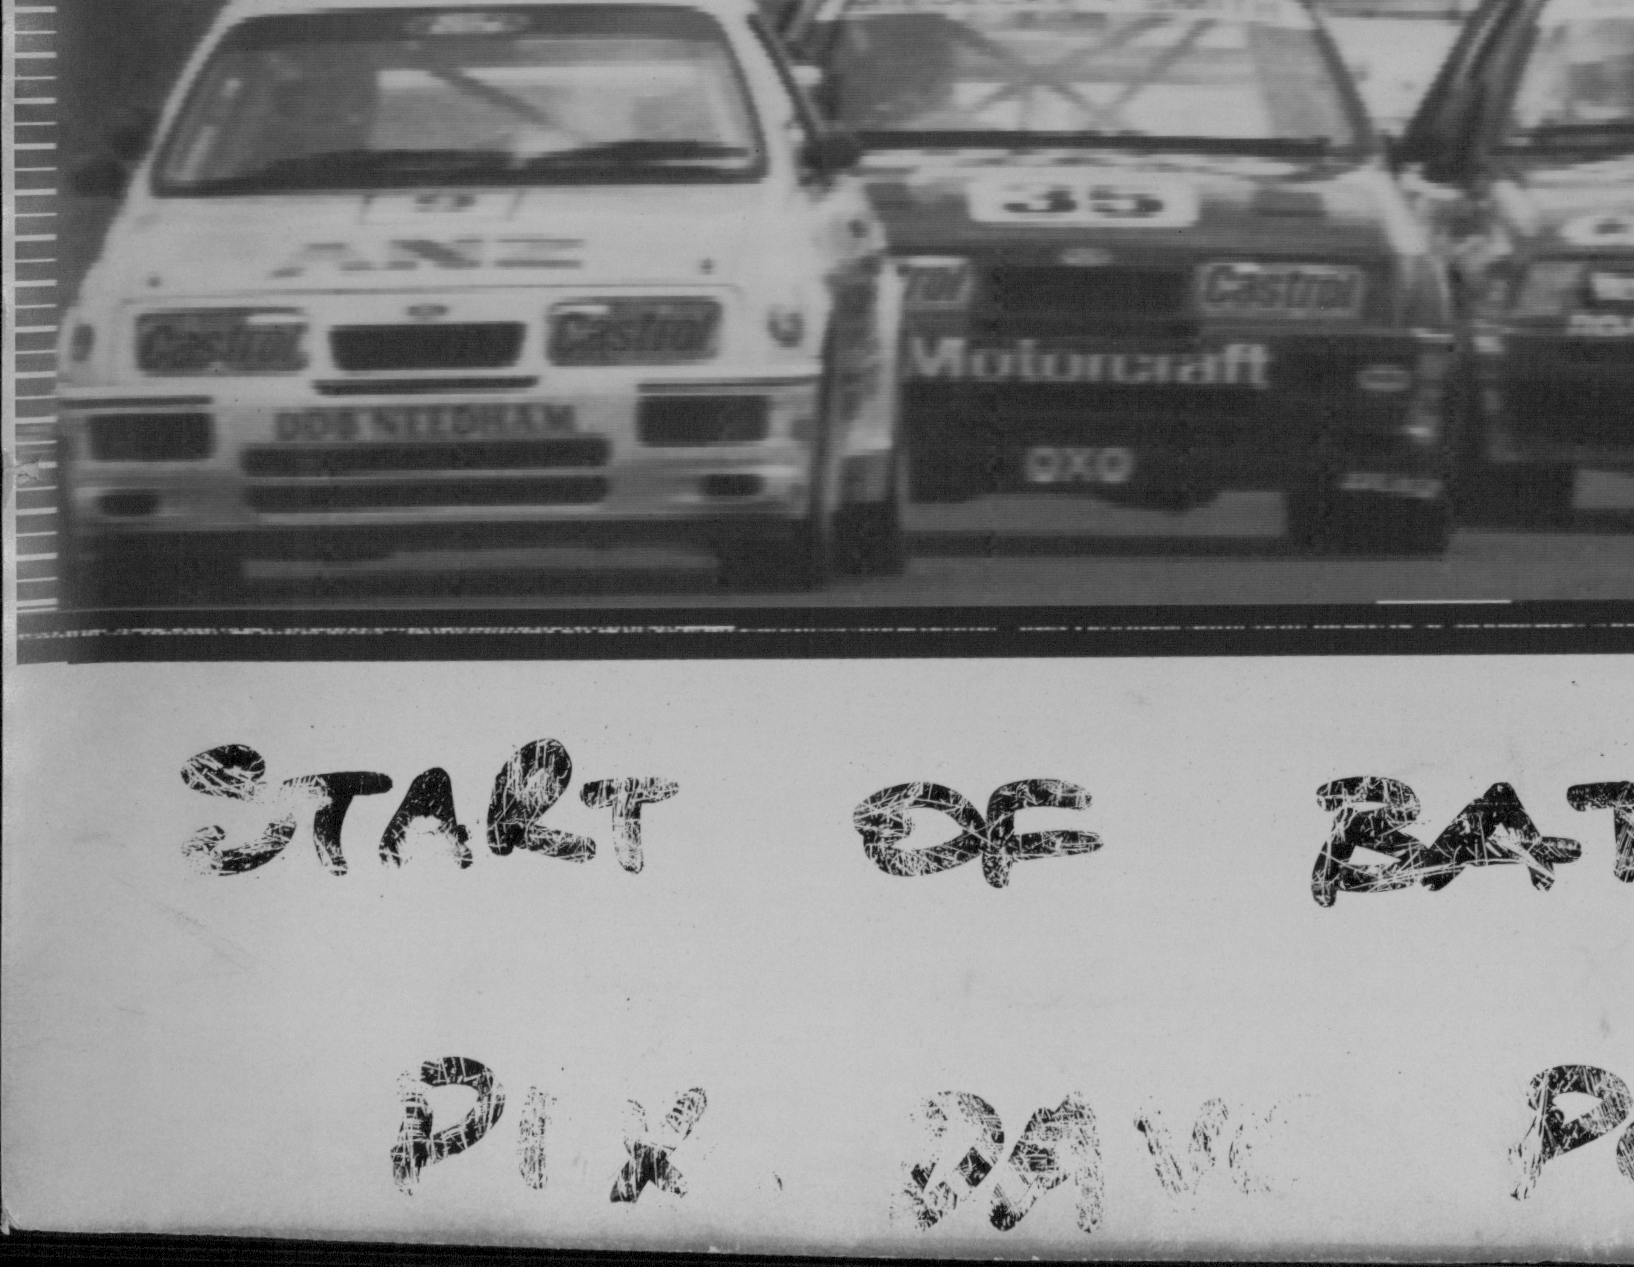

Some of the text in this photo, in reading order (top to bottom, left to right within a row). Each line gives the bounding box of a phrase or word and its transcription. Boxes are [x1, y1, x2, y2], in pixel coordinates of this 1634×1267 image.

[1000, 182, 1164, 215] 35
[268, 238, 586, 279] ANZ
[1205, 268, 1358, 309] Castrol
[142, 321, 302, 370] Castrol
[556, 309, 716, 357] Castrol
[908, 336, 1272, 391] Motorcraft
[1025, 447, 1135, 485] OXO
[181, 739, 678, 876] START
[853, 779, 1103, 889] OF
